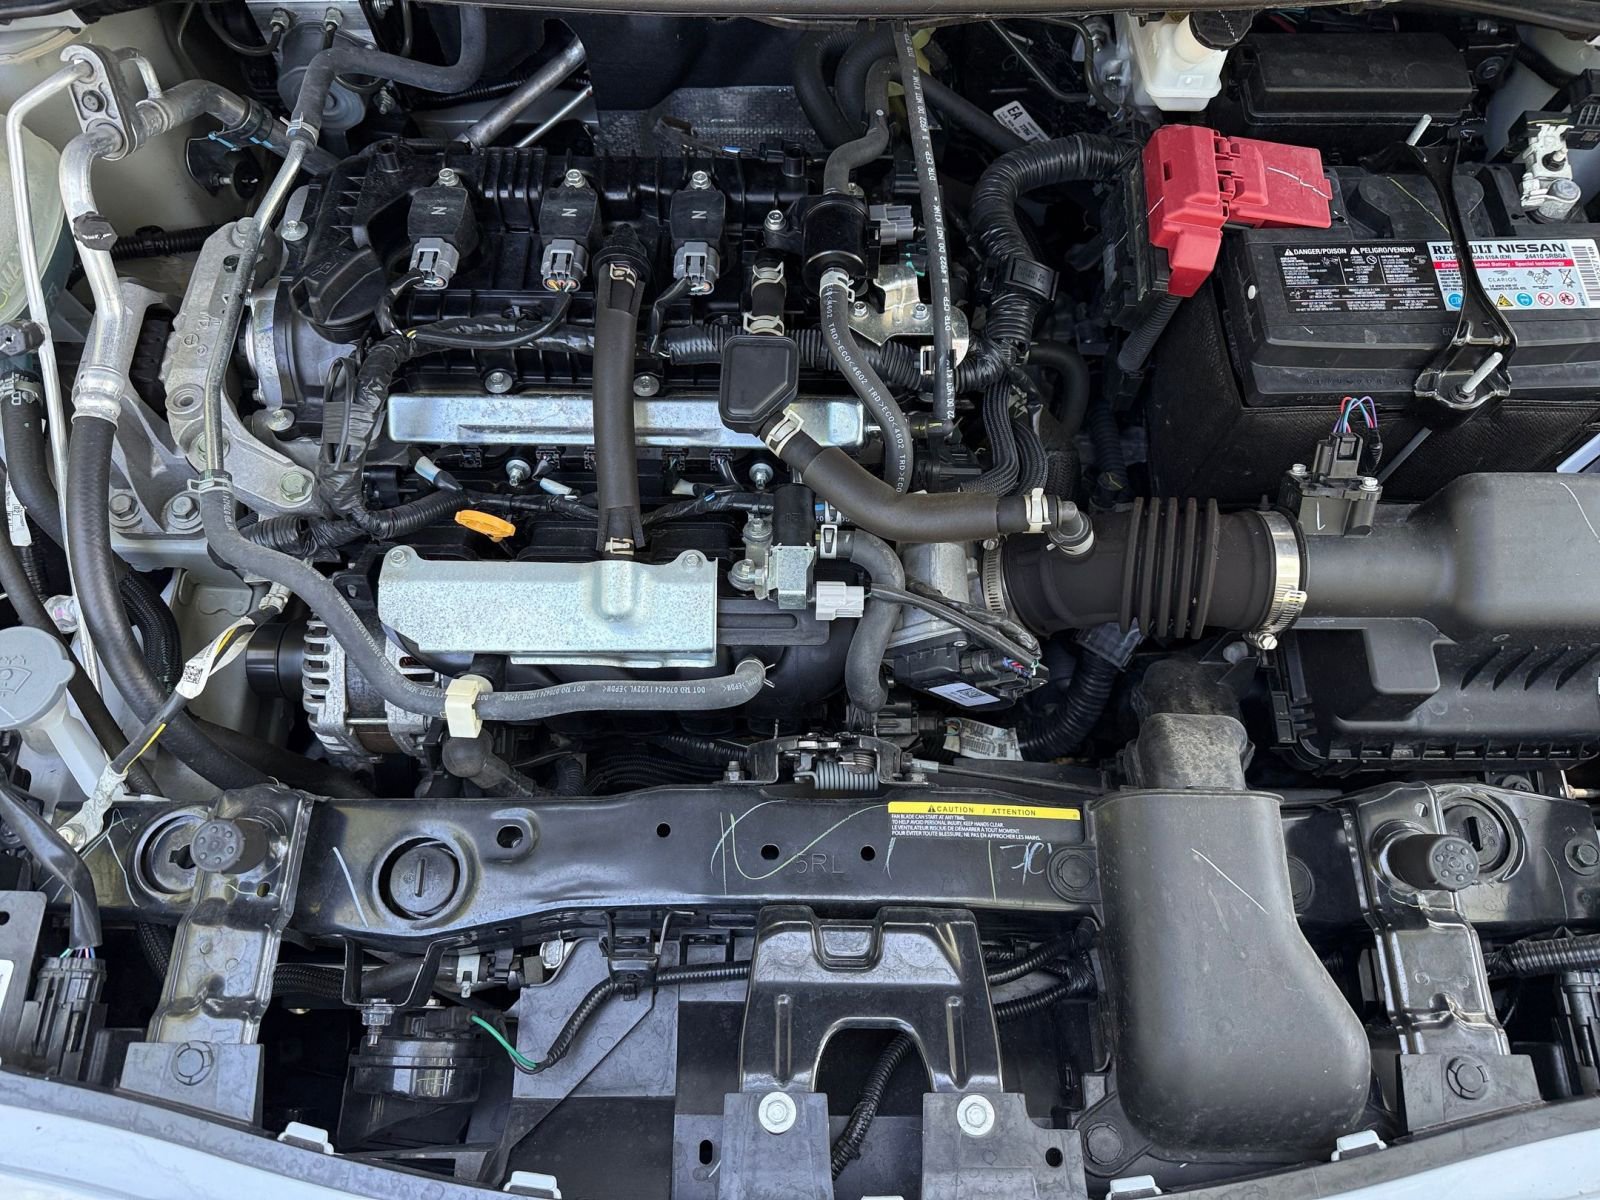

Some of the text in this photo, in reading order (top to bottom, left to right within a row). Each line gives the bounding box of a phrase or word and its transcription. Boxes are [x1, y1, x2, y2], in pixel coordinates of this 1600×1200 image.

[1008, 106, 1023, 120] EA
[936, 226, 944, 240] NOT
[938, 242, 946, 253] DO
[1432, 243, 1566, 254] REULT NISSAN
[940, 256, 948, 274] 4922
[992, 808, 1036, 816] ATTENTION
